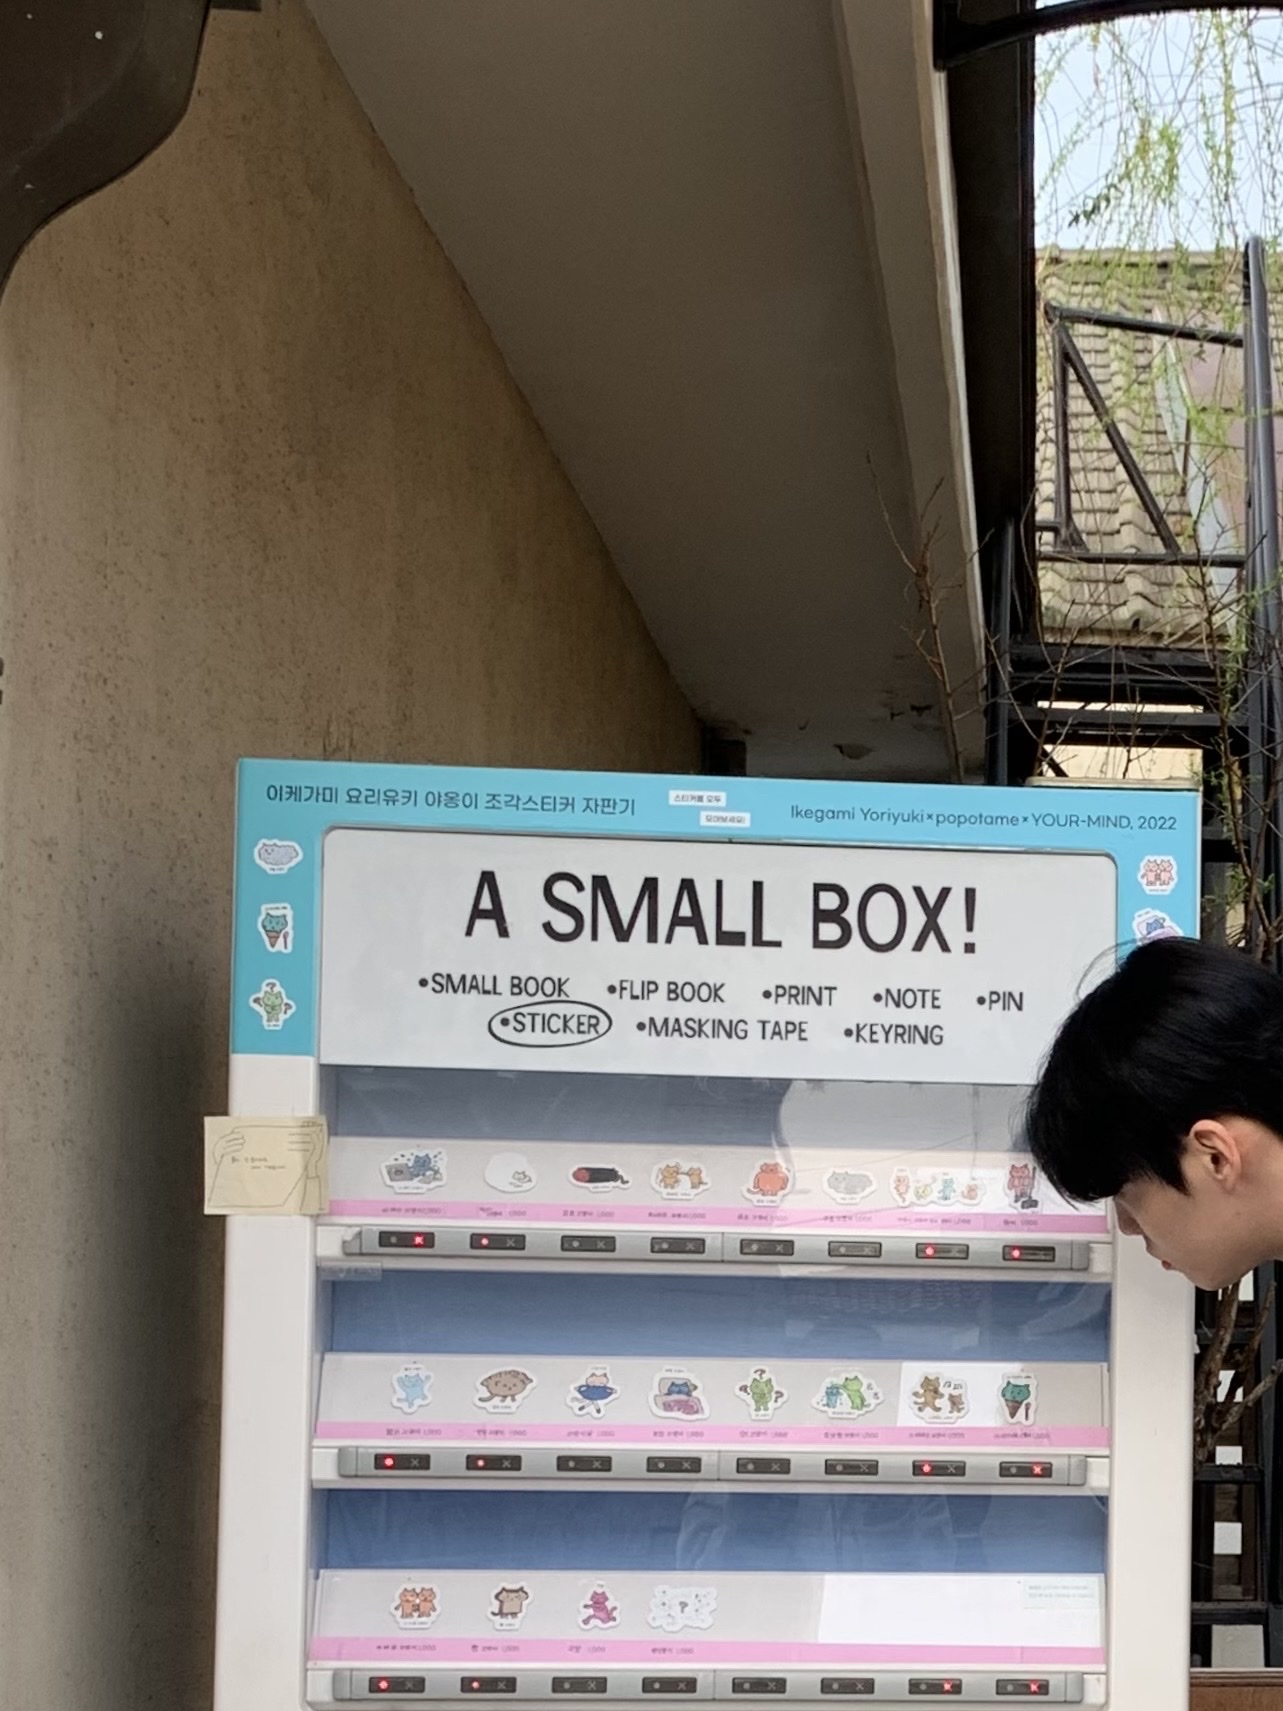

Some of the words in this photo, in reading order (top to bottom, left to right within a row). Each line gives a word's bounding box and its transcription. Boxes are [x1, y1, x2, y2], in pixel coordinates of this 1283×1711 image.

[266, 784, 338, 804] 이케가미
[346, 787, 417, 807] 요리유키
[425, 790, 478, 809] 야옹이
[484, 792, 575, 814] 조각스티커
[582, 797, 635, 816] 자판기
[791, 805, 855, 823] Ikegami
[1138, 816, 1176, 830] 2022
[465, 870, 510, 938] A
[542, 871, 782, 947] SMALL
[812, 882, 976, 954] BOX!
[431, 973, 502, 996] SMALL
[510, 976, 570, 998] BOOK
[619, 980, 659, 1000] FLIP
[667, 982, 726, 1003] BOOK
[774, 985, 837, 1006] PRINT
[885, 988, 941, 1009] NOTE
[989, 991, 1024, 1011] PIN
[512, 1012, 600, 1035] STICKER
[648, 1017, 748, 1040] MASKING
[758, 1020, 808, 1041] TAPE
[855, 1023, 944, 1046] KEYRING
